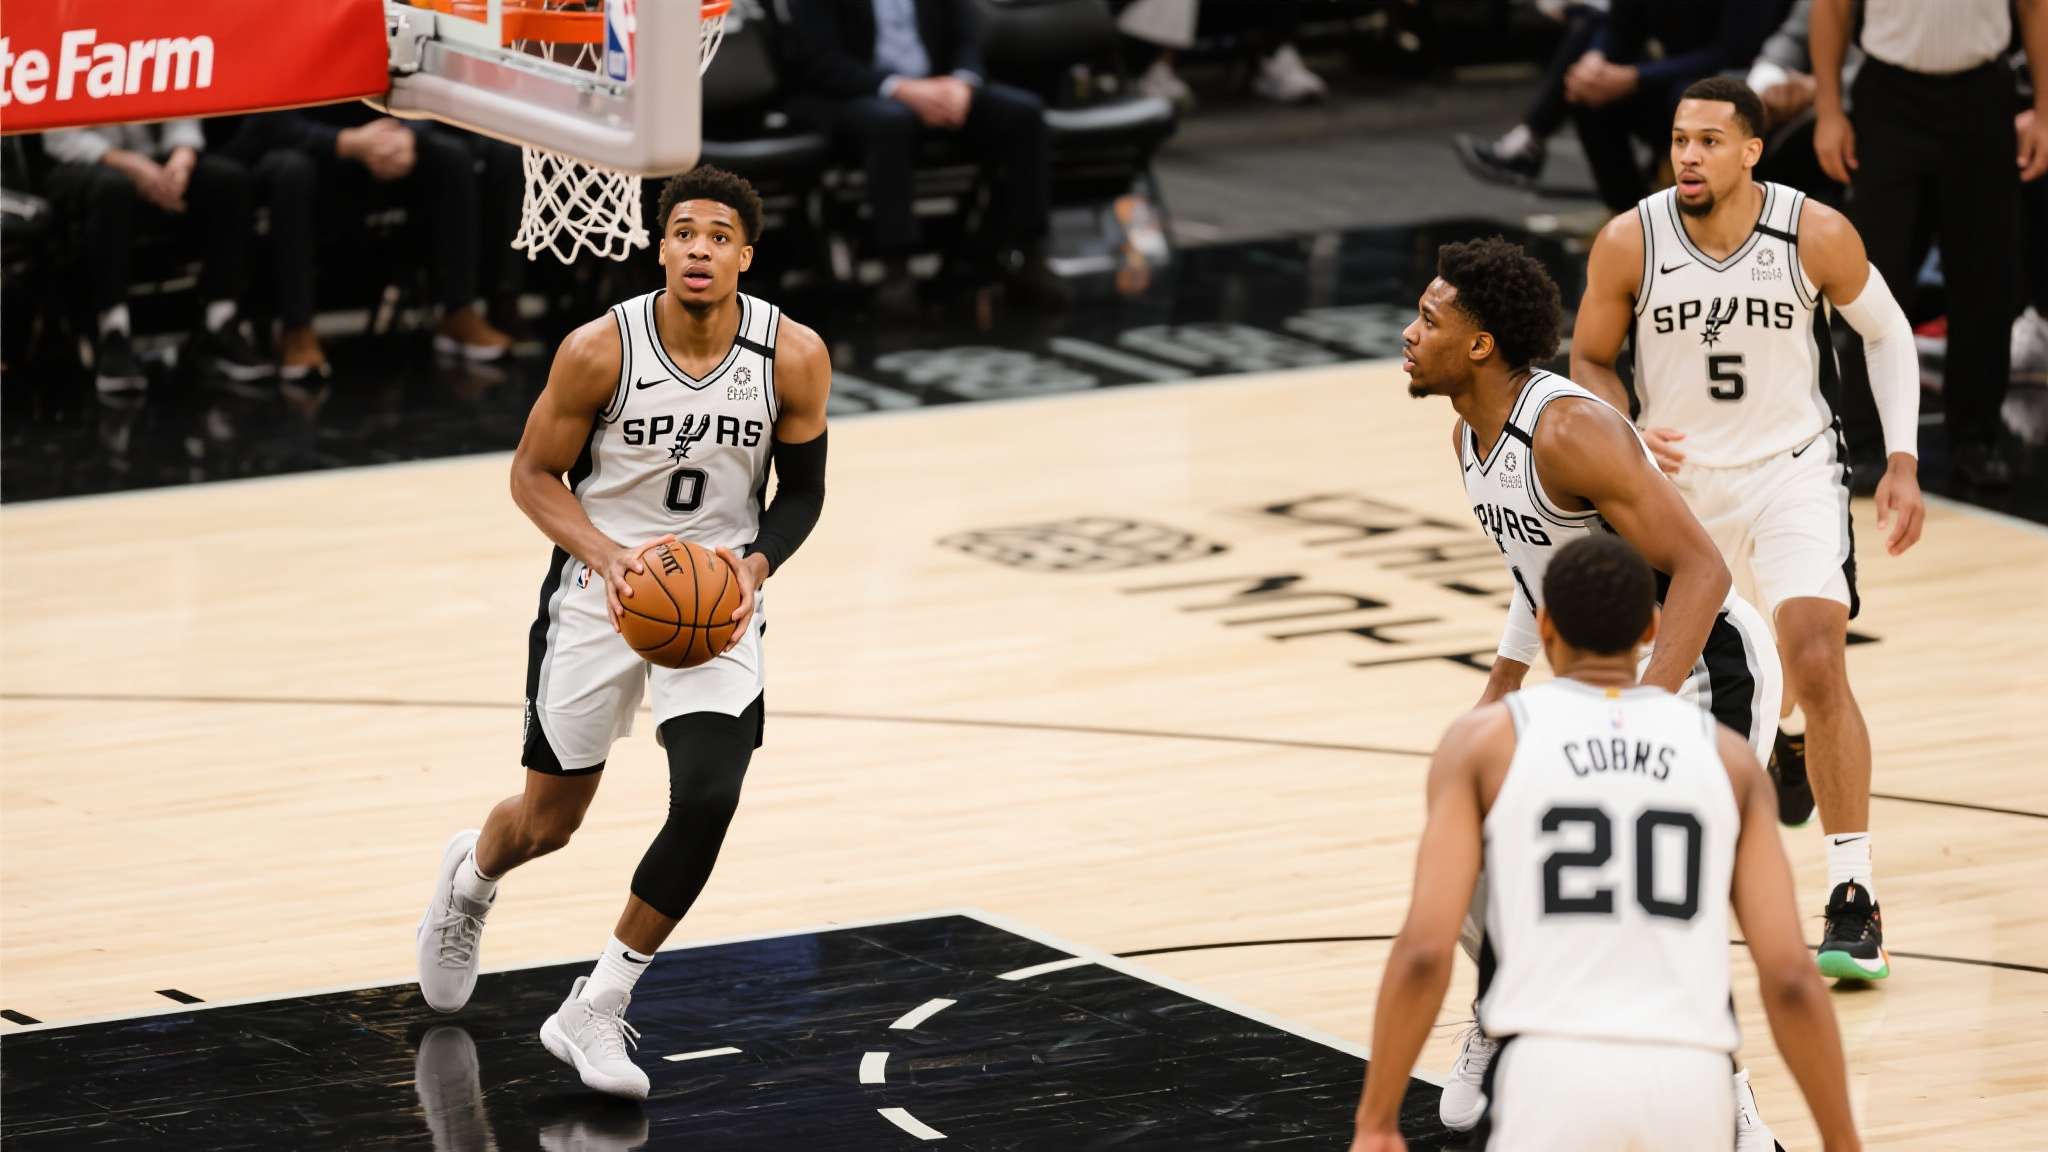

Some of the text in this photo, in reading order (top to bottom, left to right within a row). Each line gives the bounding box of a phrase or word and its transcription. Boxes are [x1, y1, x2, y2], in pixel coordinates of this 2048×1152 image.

[55, 28, 214, 101] Farm
[1653, 297, 1794, 350] SPURS
[1707, 353, 1746, 402] 5
[623, 413, 763, 464] SPURS
[665, 468, 708, 513] 0
[1473, 503, 1552, 554] PURS
[1539, 806, 1704, 922] 20
